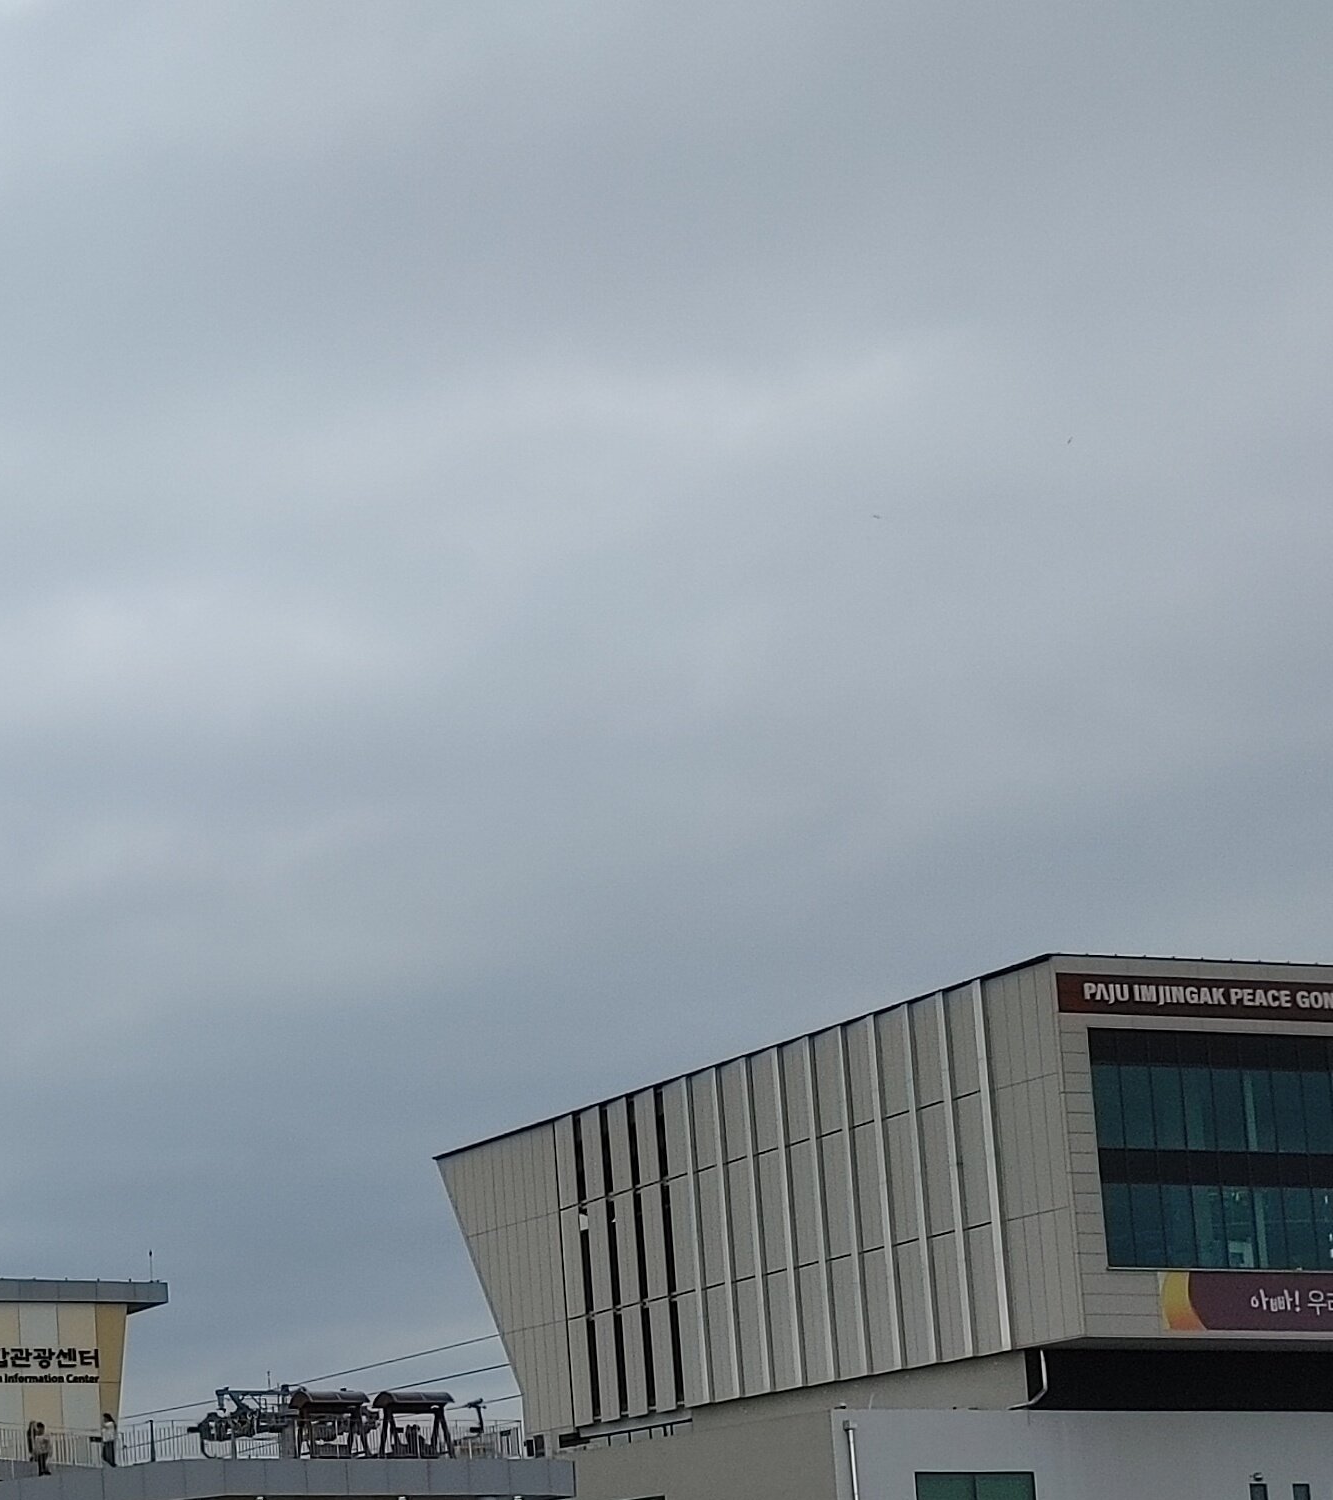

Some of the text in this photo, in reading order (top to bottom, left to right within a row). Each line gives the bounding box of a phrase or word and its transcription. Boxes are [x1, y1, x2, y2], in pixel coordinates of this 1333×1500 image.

[1083, 982, 1130, 1005] PAJU
[1133, 984, 1226, 1006] IMJINGAK
[1230, 987, 1292, 1007] PEACE
[1250, 1288, 1301, 1313] 아빠!
[4, 1373, 64, 1384] Information
[66, 1373, 99, 1384] Center
